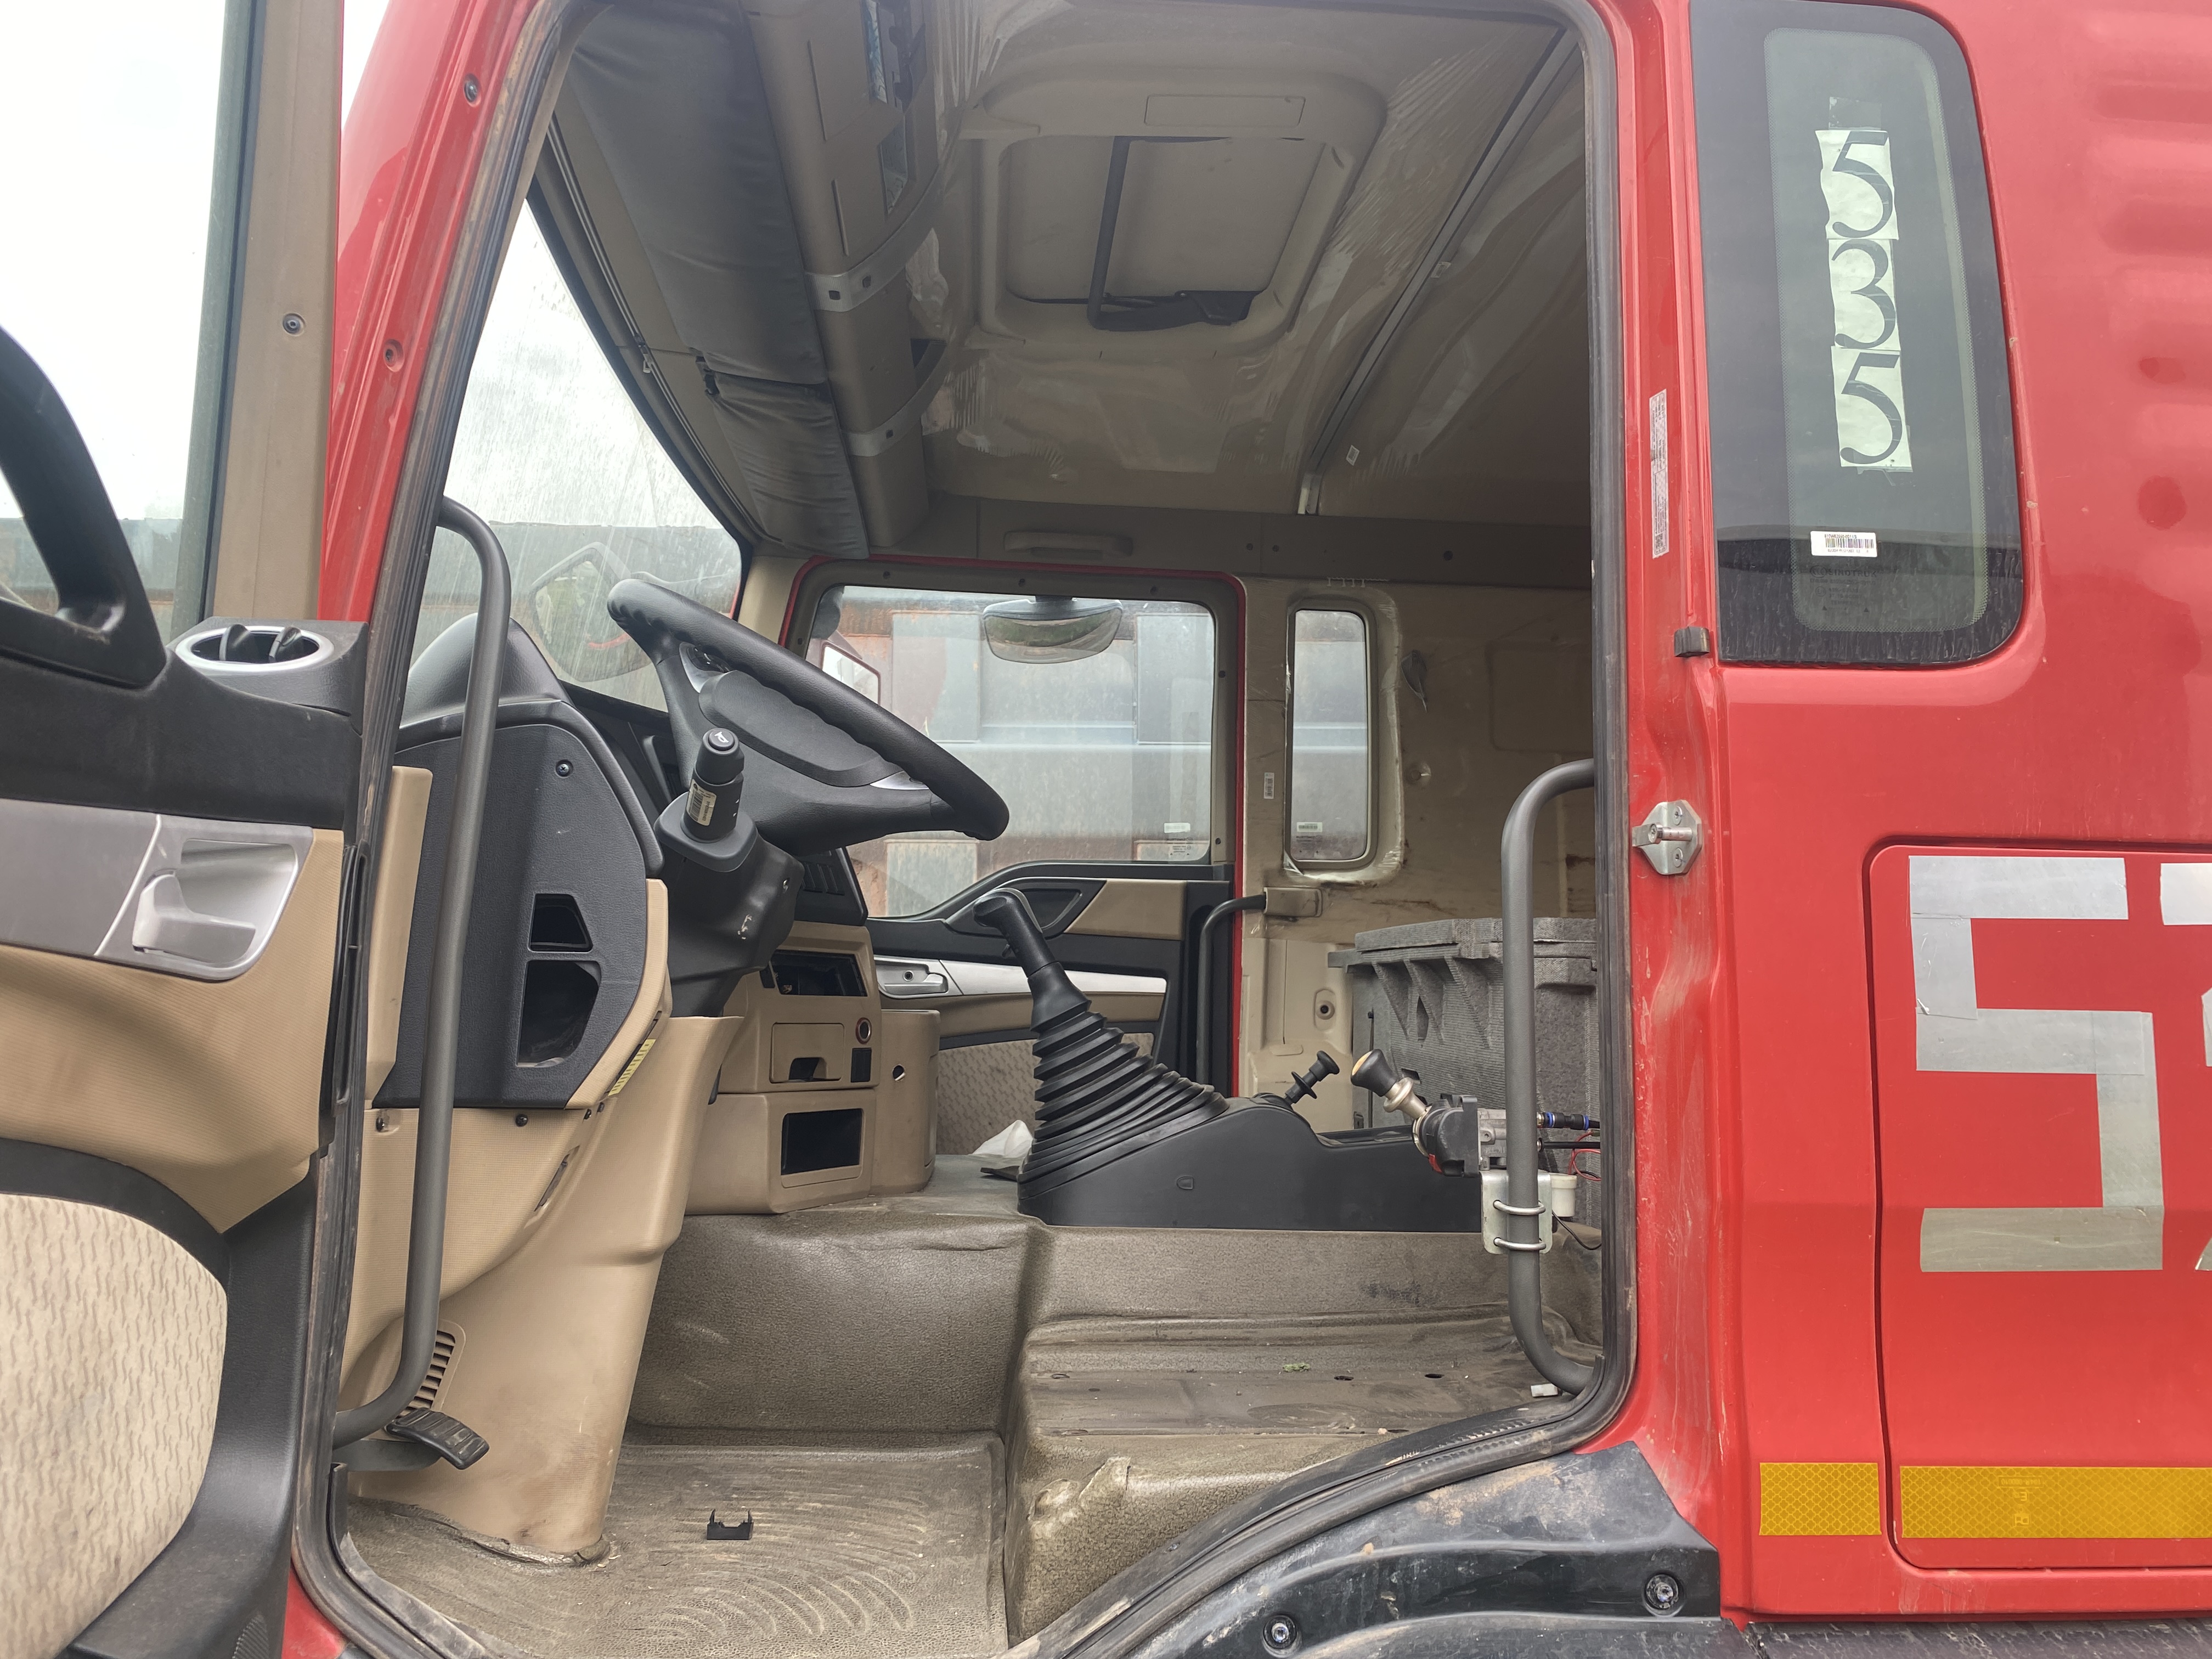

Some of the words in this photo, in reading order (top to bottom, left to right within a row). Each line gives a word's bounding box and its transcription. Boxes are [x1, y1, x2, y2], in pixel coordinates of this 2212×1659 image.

[1832, 130, 1903, 465] 535
[1827, 568, 1877, 578] SINOTRUK
[1909, 855, 2212, 1272] 5
